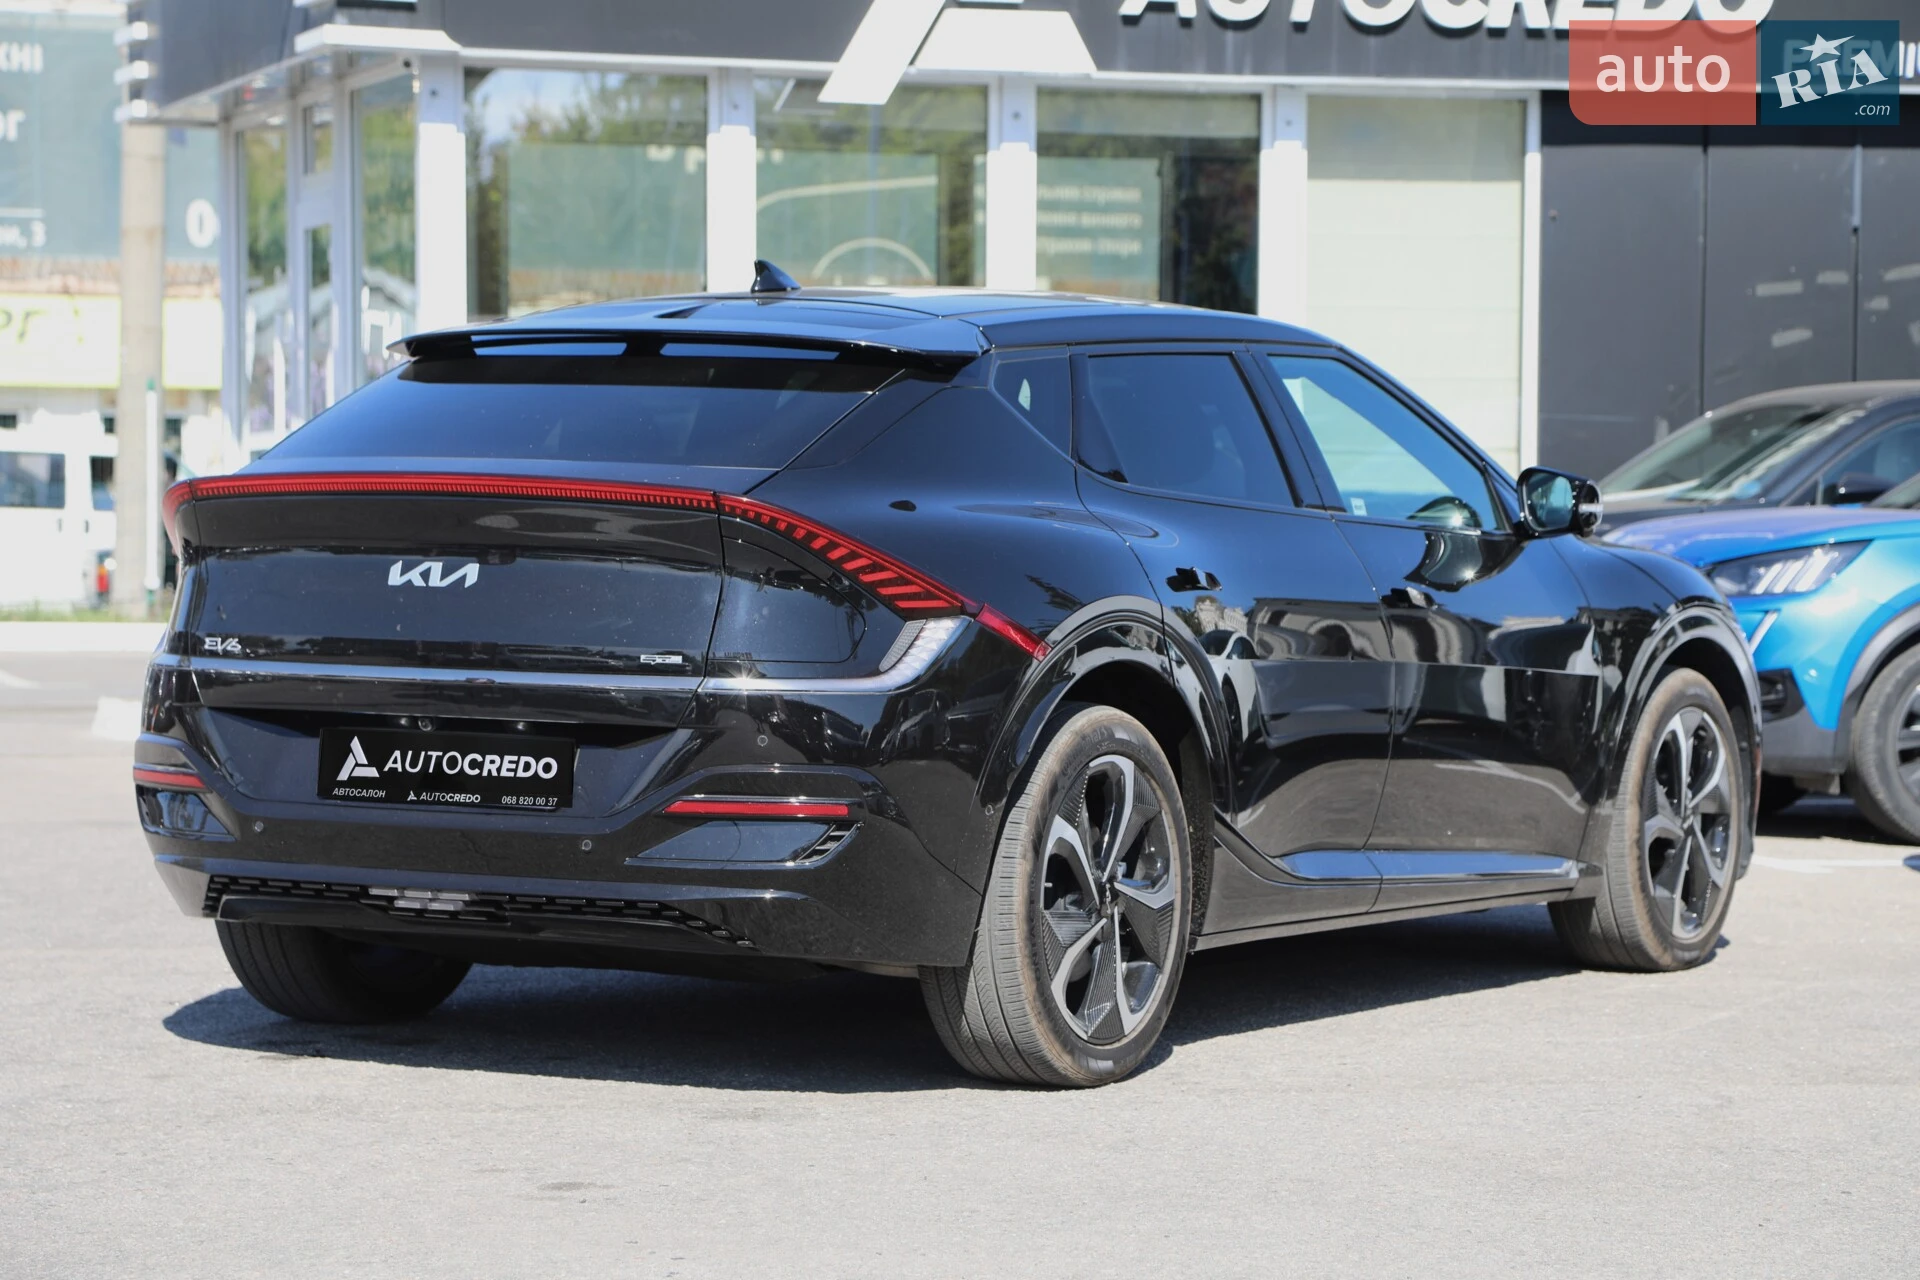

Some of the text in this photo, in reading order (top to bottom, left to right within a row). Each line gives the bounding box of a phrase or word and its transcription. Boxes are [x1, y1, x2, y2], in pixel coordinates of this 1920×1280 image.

[387, 560, 480, 588] KIA
[204, 637, 242, 654] EV6
[383, 750, 558, 779] AUTOCREDO
[332, 787, 386, 798] АВТОСАЛОН
[419, 791, 481, 803] AUTOCREDO
[501, 795, 558, 806] 068 820 00 37
